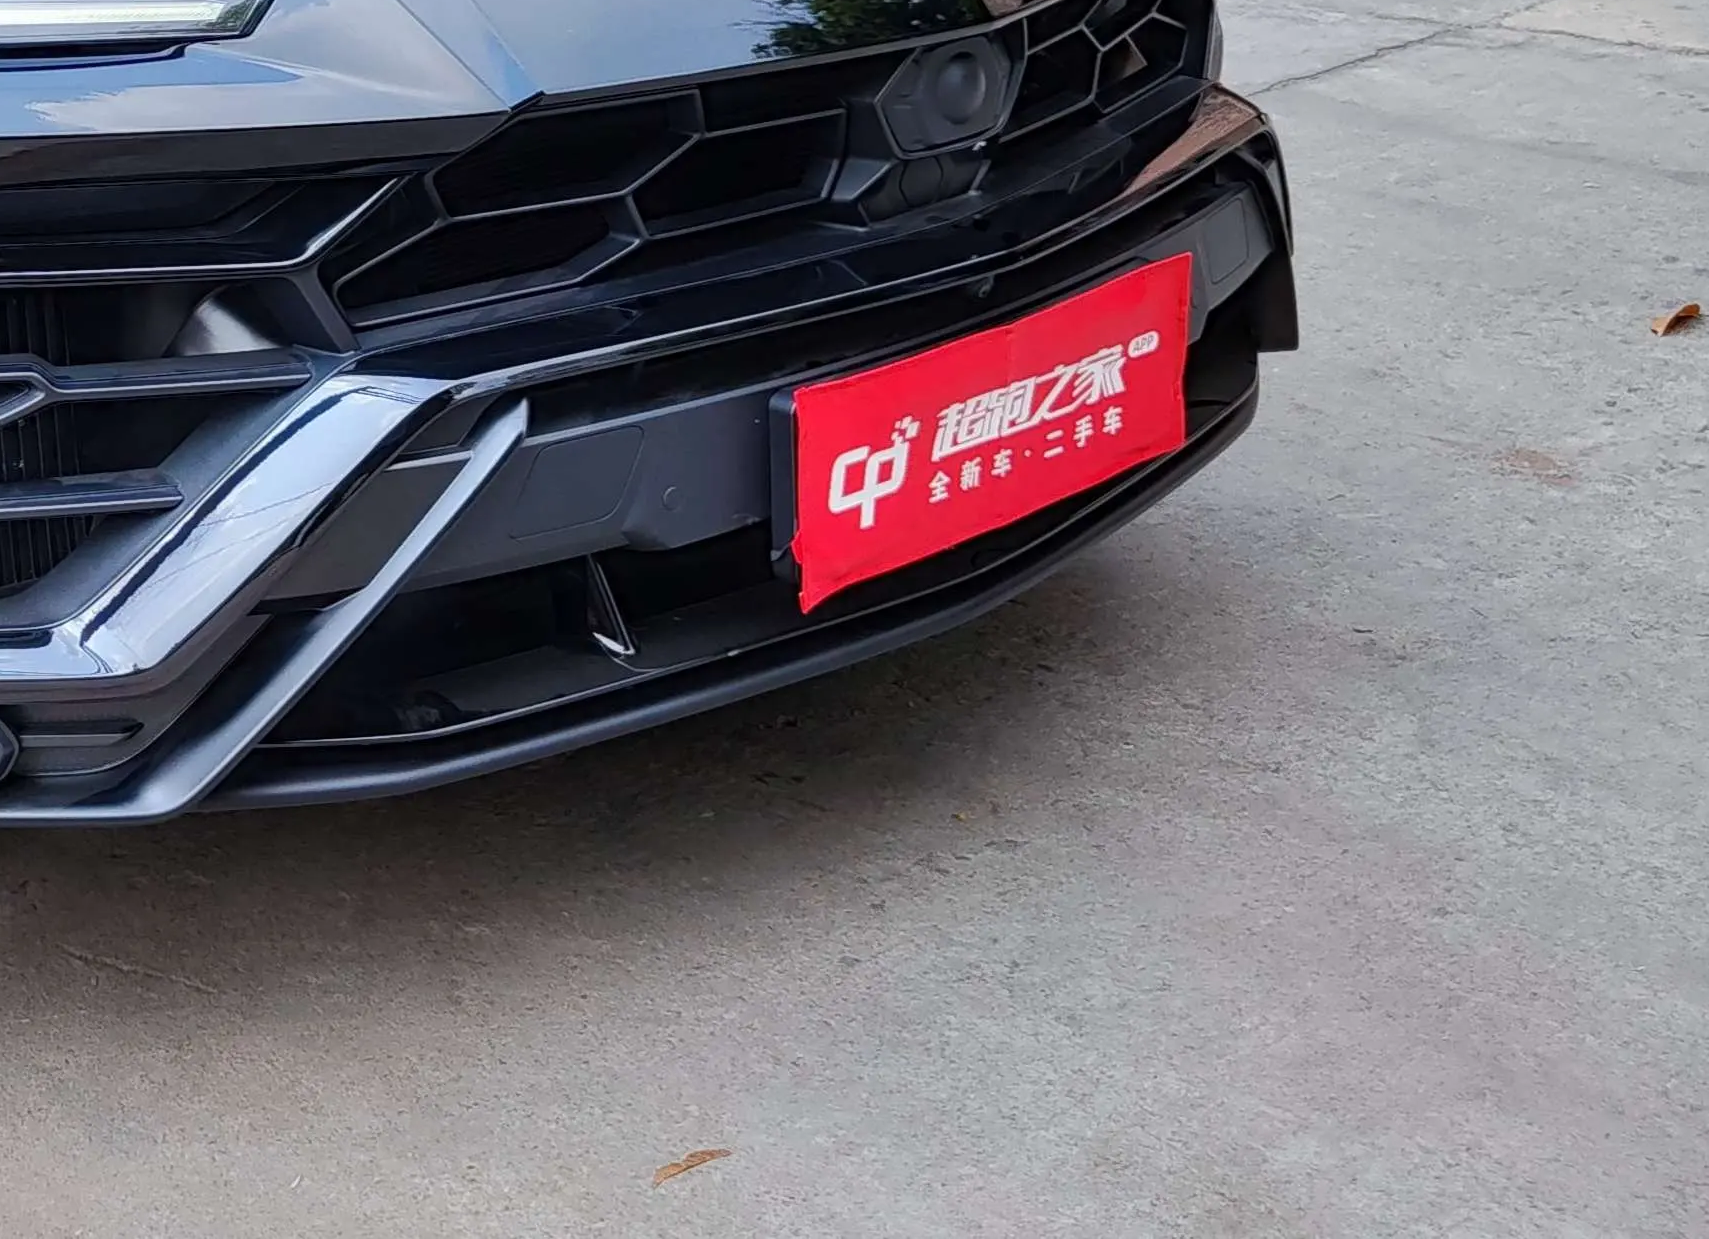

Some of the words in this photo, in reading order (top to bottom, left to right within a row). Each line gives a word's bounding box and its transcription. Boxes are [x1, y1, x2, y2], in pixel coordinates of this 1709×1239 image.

[931, 344, 1126, 462] 超跑之家
[1132, 334, 1155, 353] APP
